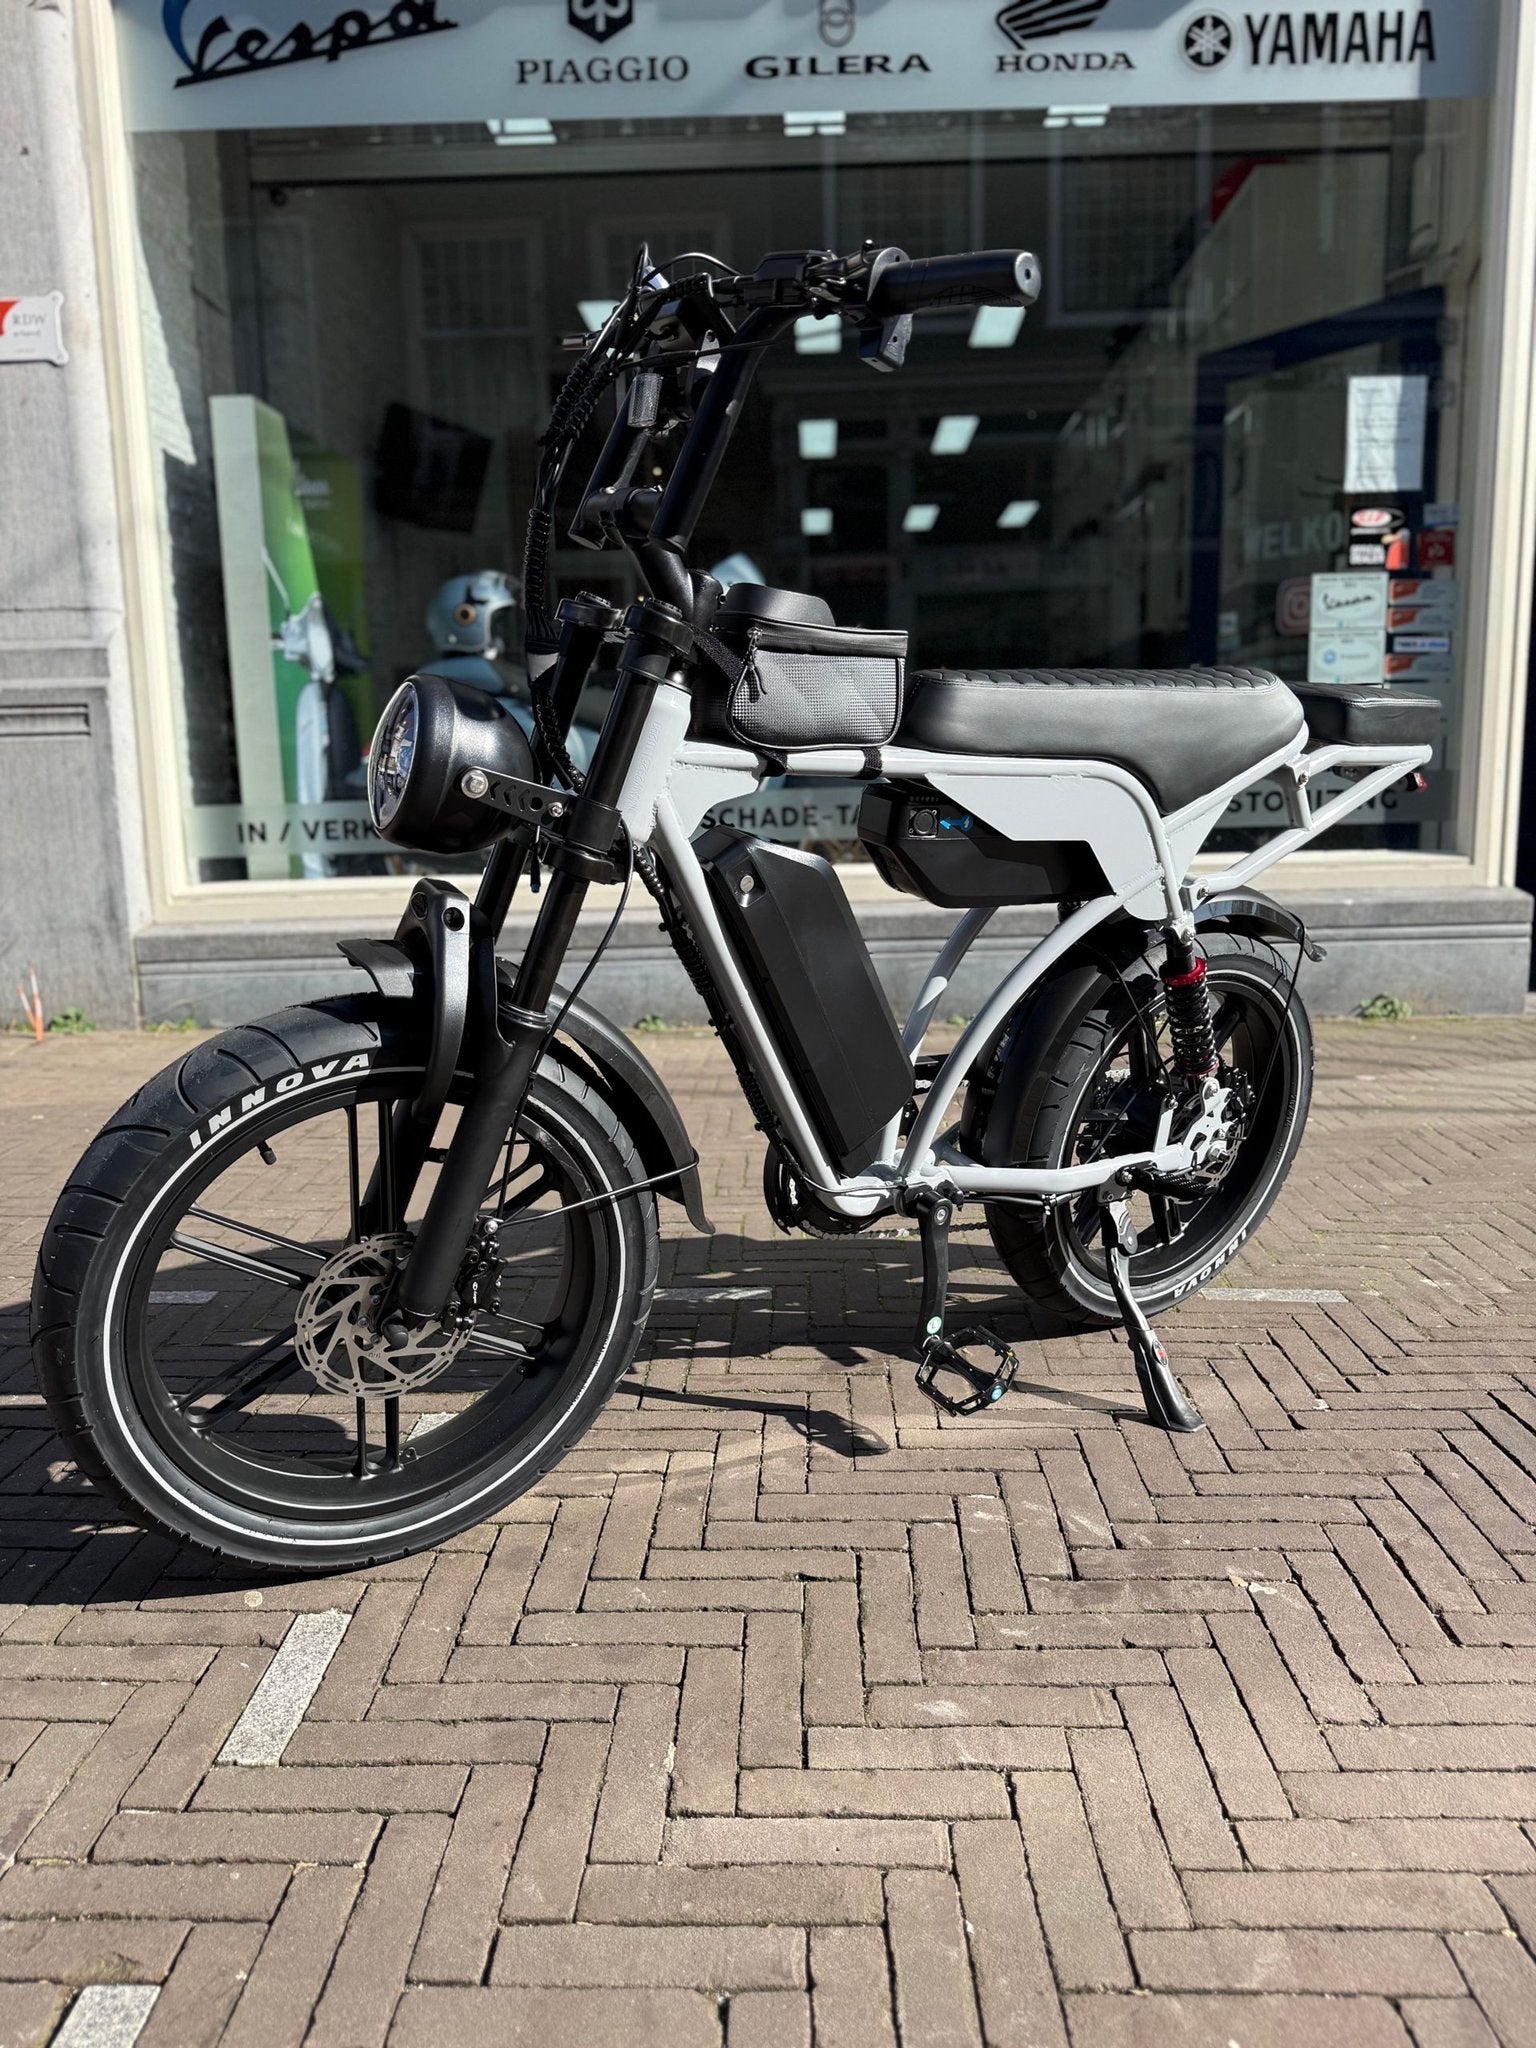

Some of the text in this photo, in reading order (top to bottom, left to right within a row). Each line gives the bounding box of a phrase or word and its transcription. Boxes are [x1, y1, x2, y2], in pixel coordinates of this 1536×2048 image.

[161, 0, 458, 88] Vespa
[1245, 9, 1436, 66] YAMAHA
[516, 56, 690, 84] PIAGGIO
[745, 52, 932, 79] GILERA
[996, 52, 1136, 73] HONDA
[12, 312, 47, 326] RDW
[237, 819, 381, 843] IN / VERK
[189, 1053, 371, 1150] INNOVA
[1173, 1229, 1247, 1299] INNOVA
